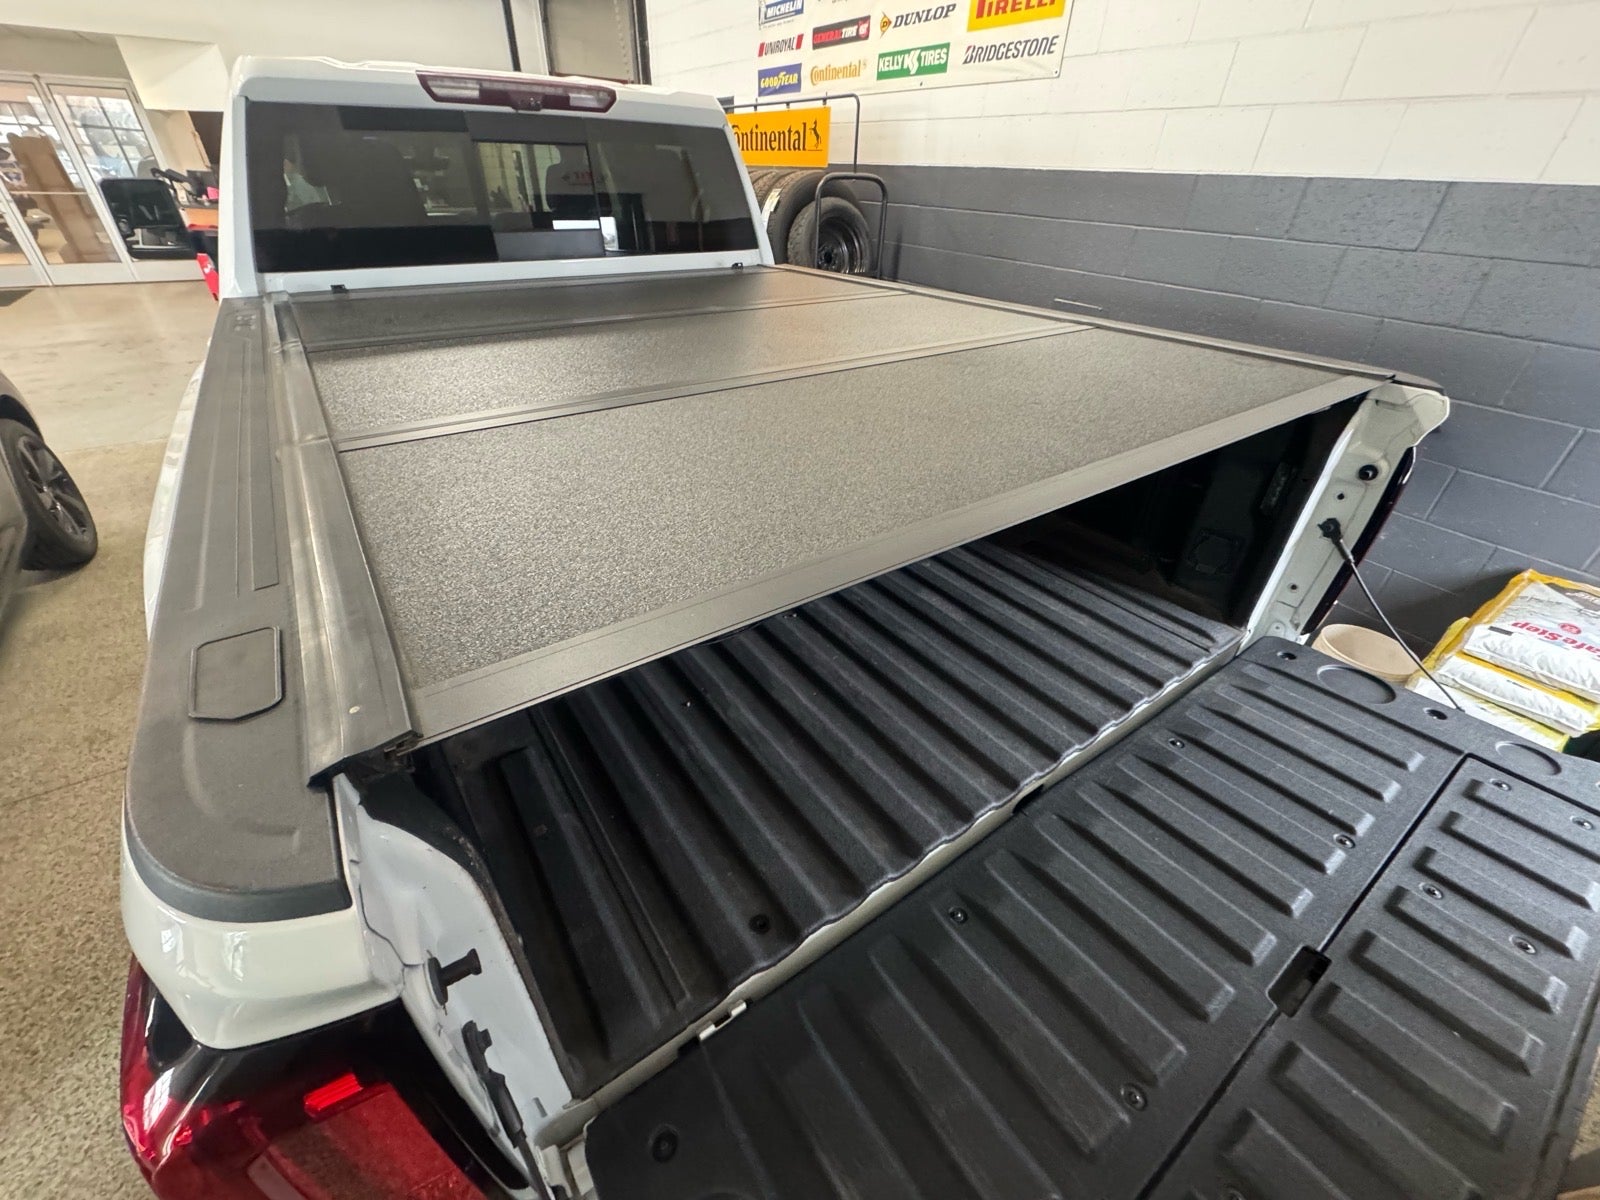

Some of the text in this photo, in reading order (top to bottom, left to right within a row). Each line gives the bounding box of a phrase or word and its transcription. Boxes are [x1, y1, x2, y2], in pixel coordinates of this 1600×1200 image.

[766, 0, 802, 18] MICHELIN
[892, 3, 957, 28] DUNLOP
[764, 37, 795, 55] UNIROYAL
[962, 35, 1060, 65] BRIDGESTONE
[878, 54, 904, 72] KELLY
[920, 48, 948, 67] TIRES
[760, 71, 798, 90] GOODYEAR
[810, 60, 861, 86] Continental
[732, 122, 807, 152] ontinental
[1511, 622, 1600, 659] afeStep
